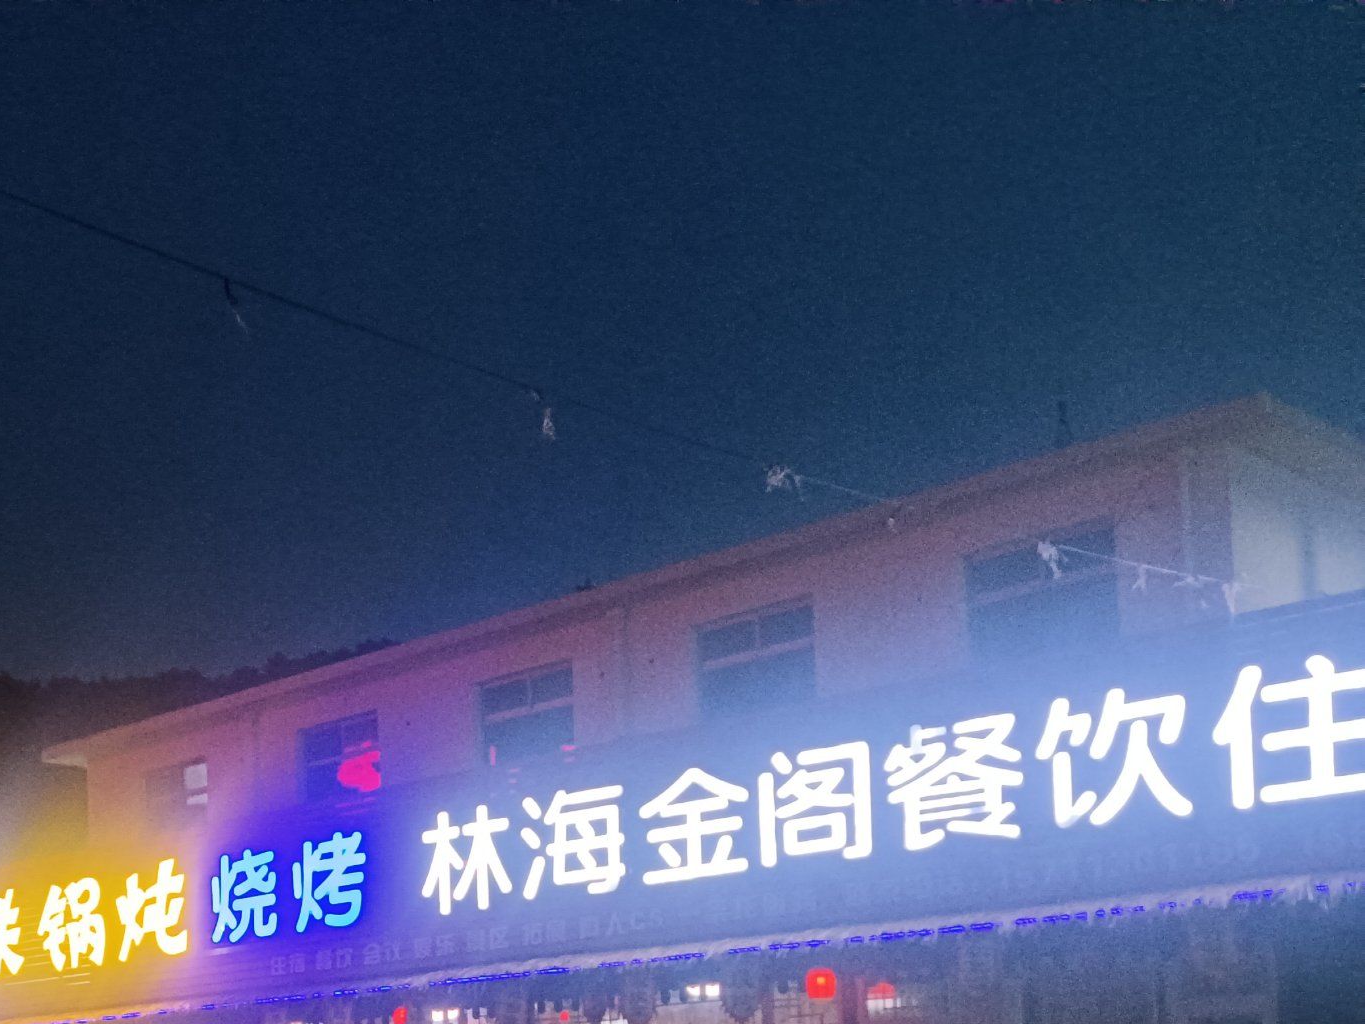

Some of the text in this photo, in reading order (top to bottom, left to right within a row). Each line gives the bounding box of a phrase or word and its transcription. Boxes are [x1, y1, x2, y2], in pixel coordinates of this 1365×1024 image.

[421, 654, 1365, 916] 林海金阁餐饮住
[211, 831, 367, 943] 烧烤
